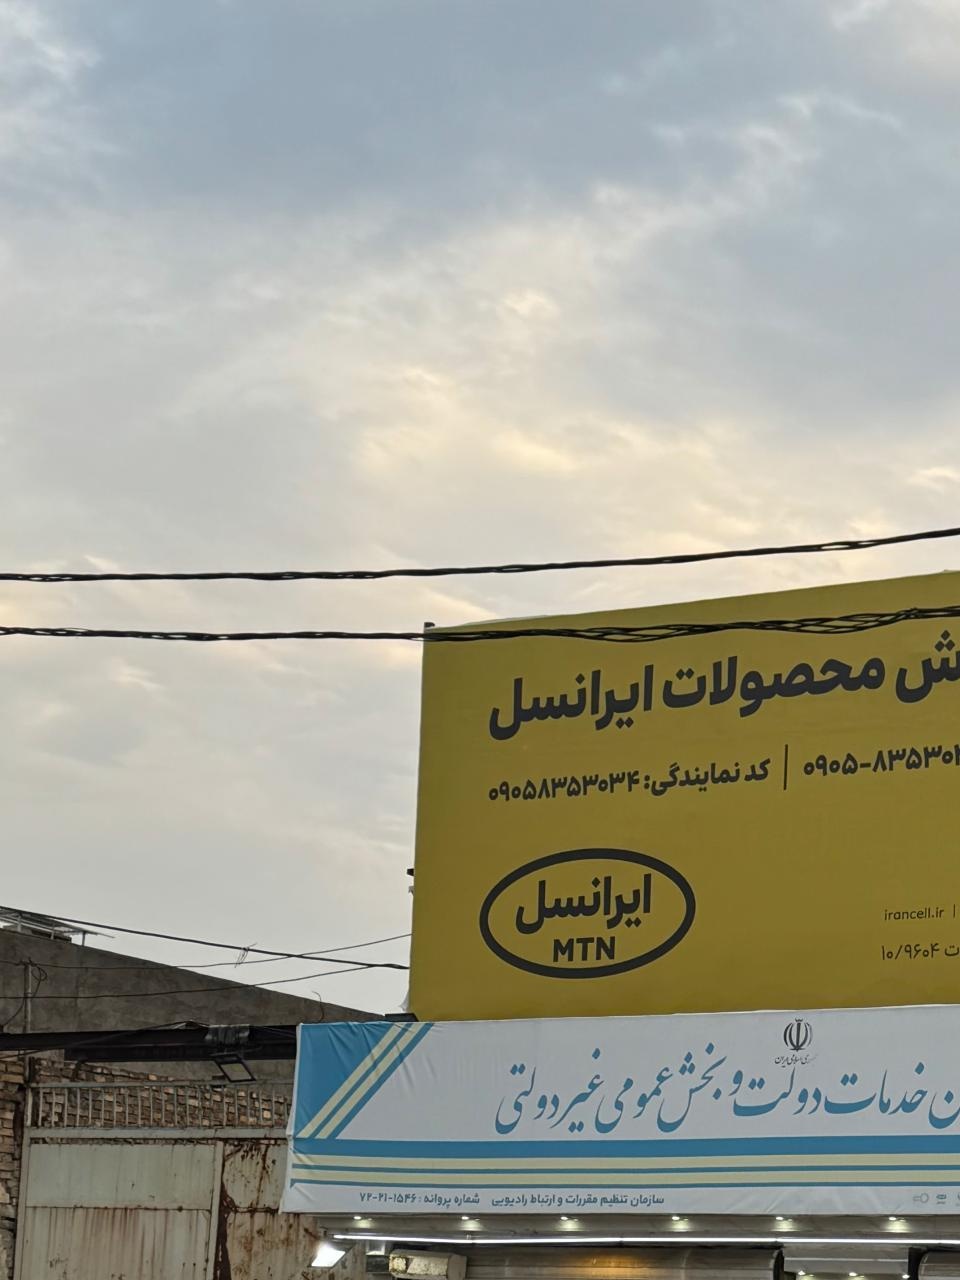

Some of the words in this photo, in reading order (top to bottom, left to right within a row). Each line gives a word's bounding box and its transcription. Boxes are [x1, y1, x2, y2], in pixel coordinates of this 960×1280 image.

[661, 655, 886, 718] محصولات
[489, 664, 654, 741] ایرانسل
[643, 762, 741, 796] نمایندگی:
[744, 758, 770, 782] کد
[488, 770, 639, 802] ۰۹۰۵۸۳۵۳۰۳۴
[515, 873, 652, 935] ایرانسل
[883, 906, 945, 922] irancell.ir
[553, 936, 616, 963] MTN
[657, 1042, 727, 1133] بخش
[729, 1068, 743, 1096] و
[733, 1061, 822, 1117] دولت
[823, 1062, 928, 1116] خدمات
[595, 1066, 674, 1134] عمومی
[454, 1192, 480, 1207] شماره
[491, 1193, 529, 1208] رادیویی
[530, 1192, 556, 1207] ارتباط
[557, 1197, 564, 1207] و
[565, 1192, 598, 1206] مقررات
[600, 1193, 628, 1209] تنظیم
[630, 1194, 665, 1207] سازمان
